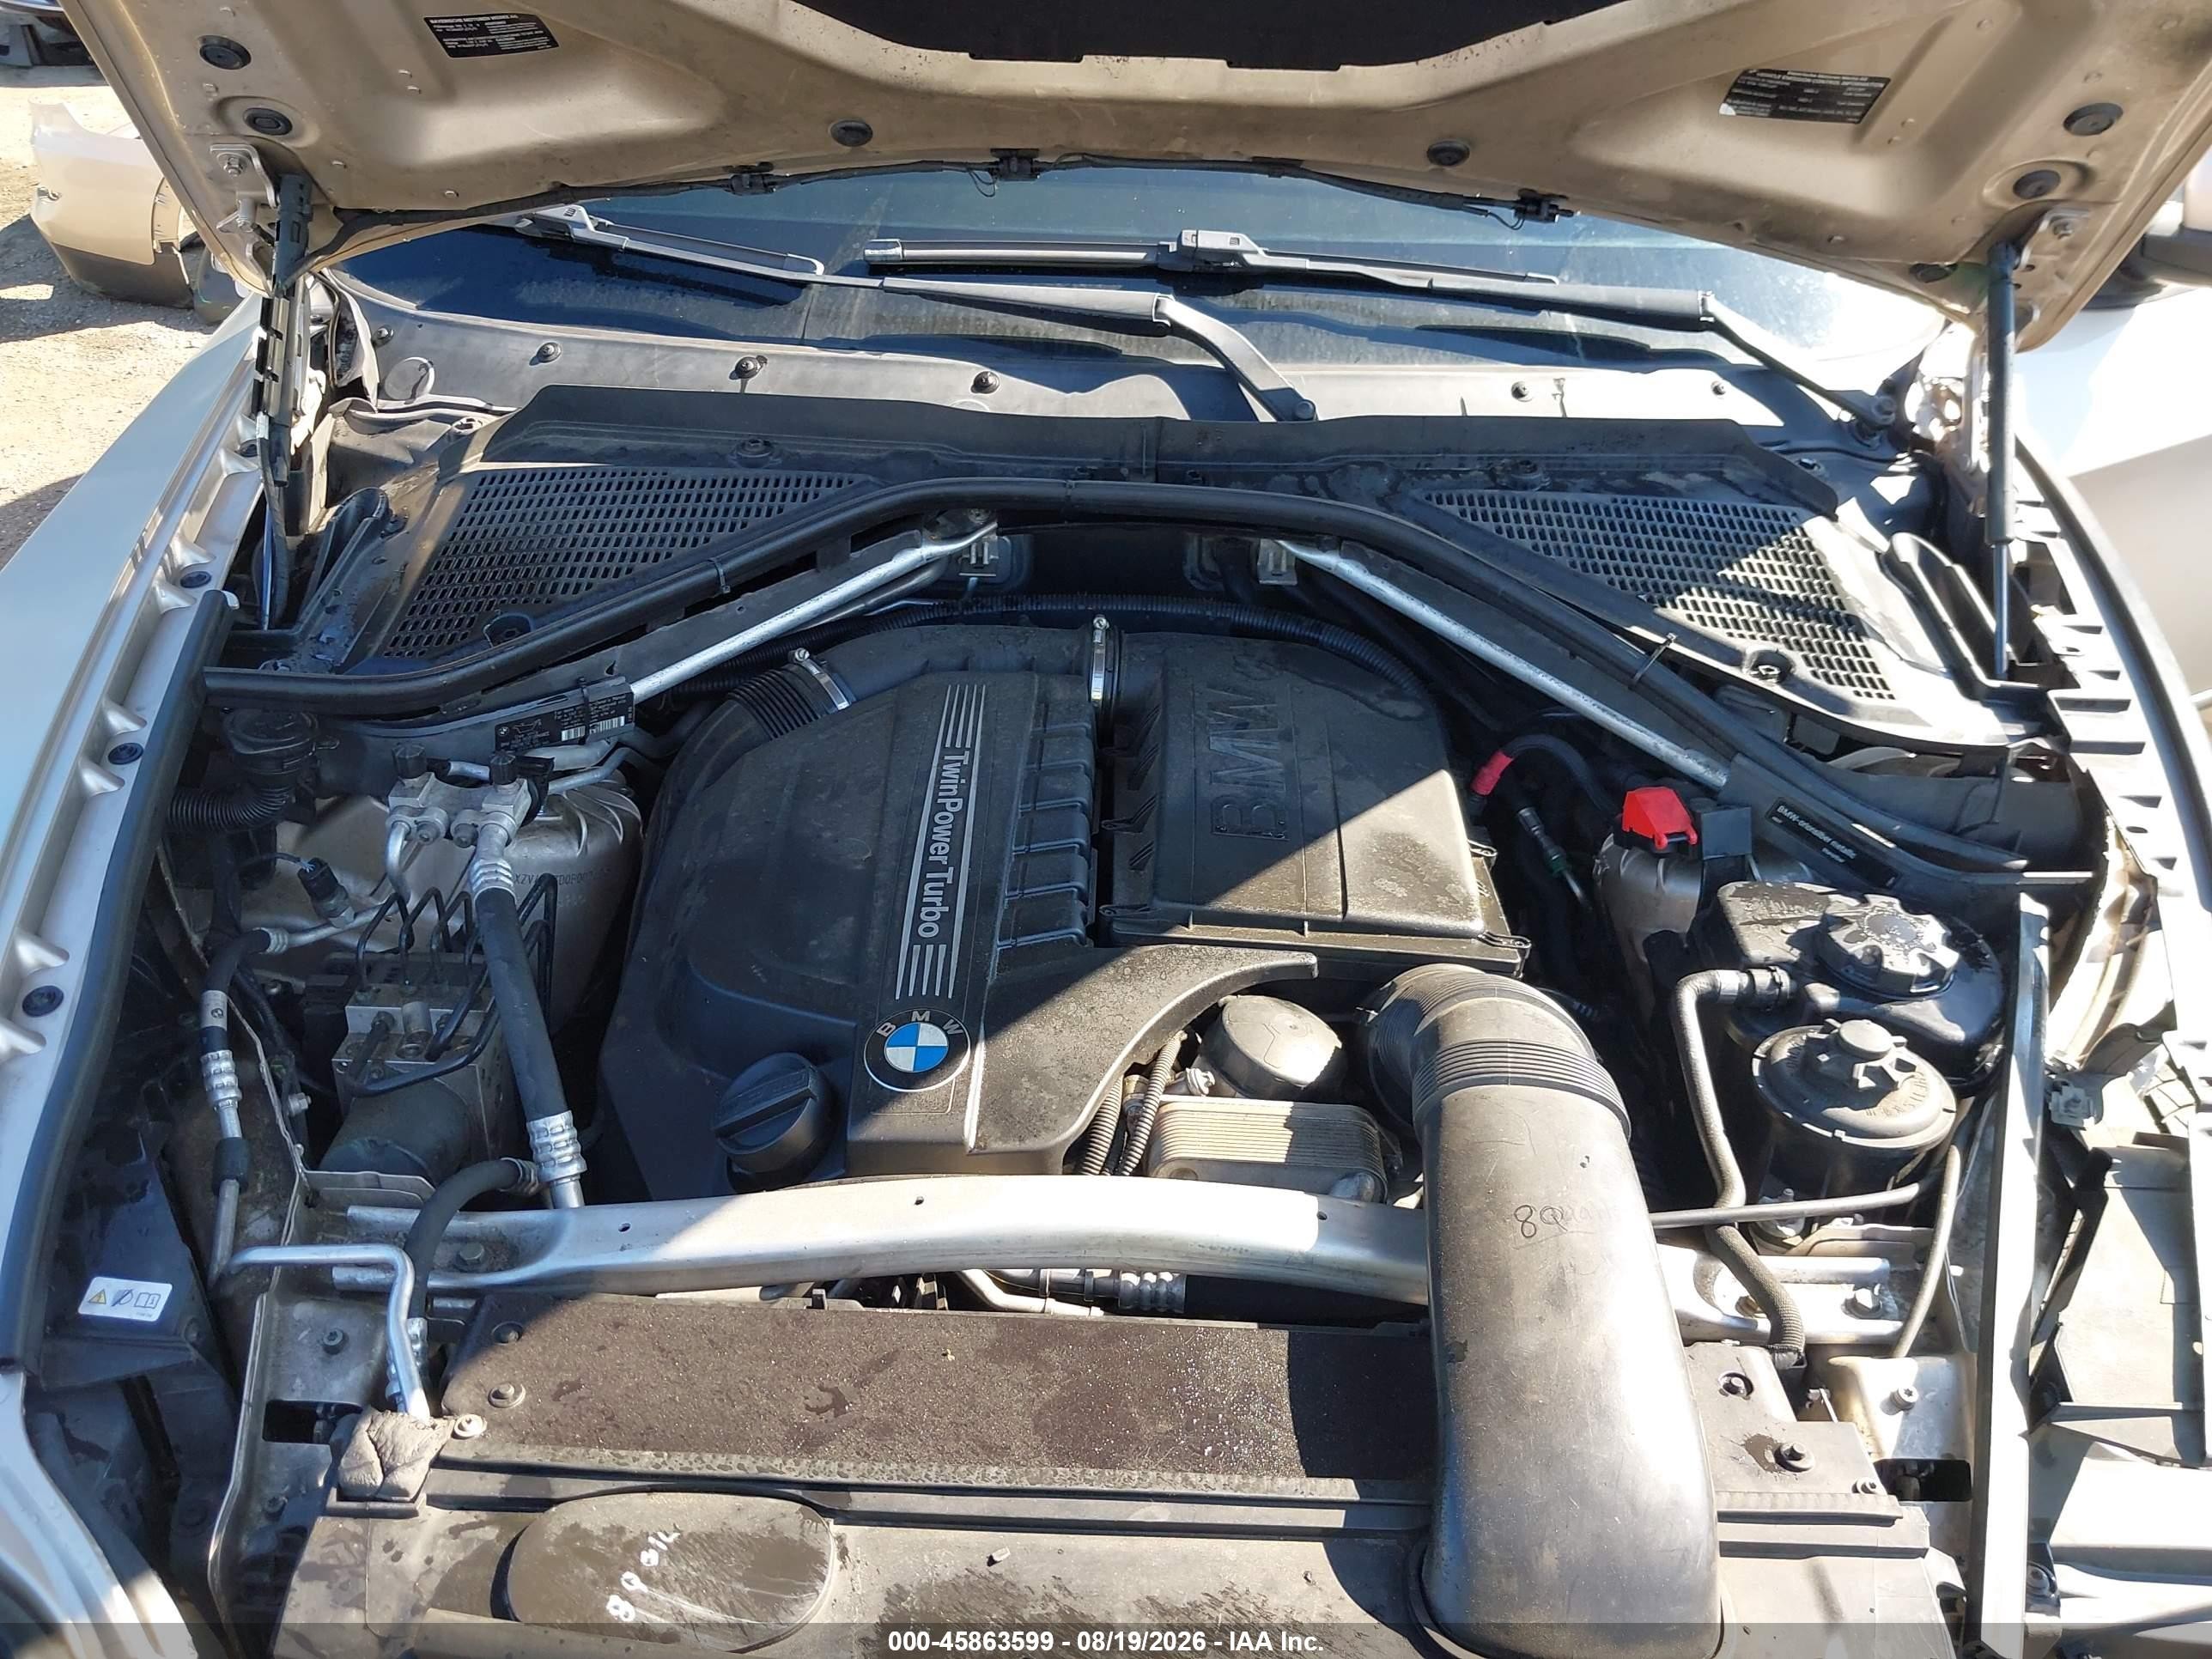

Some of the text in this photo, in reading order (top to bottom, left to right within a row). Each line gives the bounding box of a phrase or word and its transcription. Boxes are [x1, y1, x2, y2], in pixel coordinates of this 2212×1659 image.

[1207, 688, 1290, 841] BMW
[917, 866, 954, 939] Turbo
[877, 1009, 963, 1036] BMW
